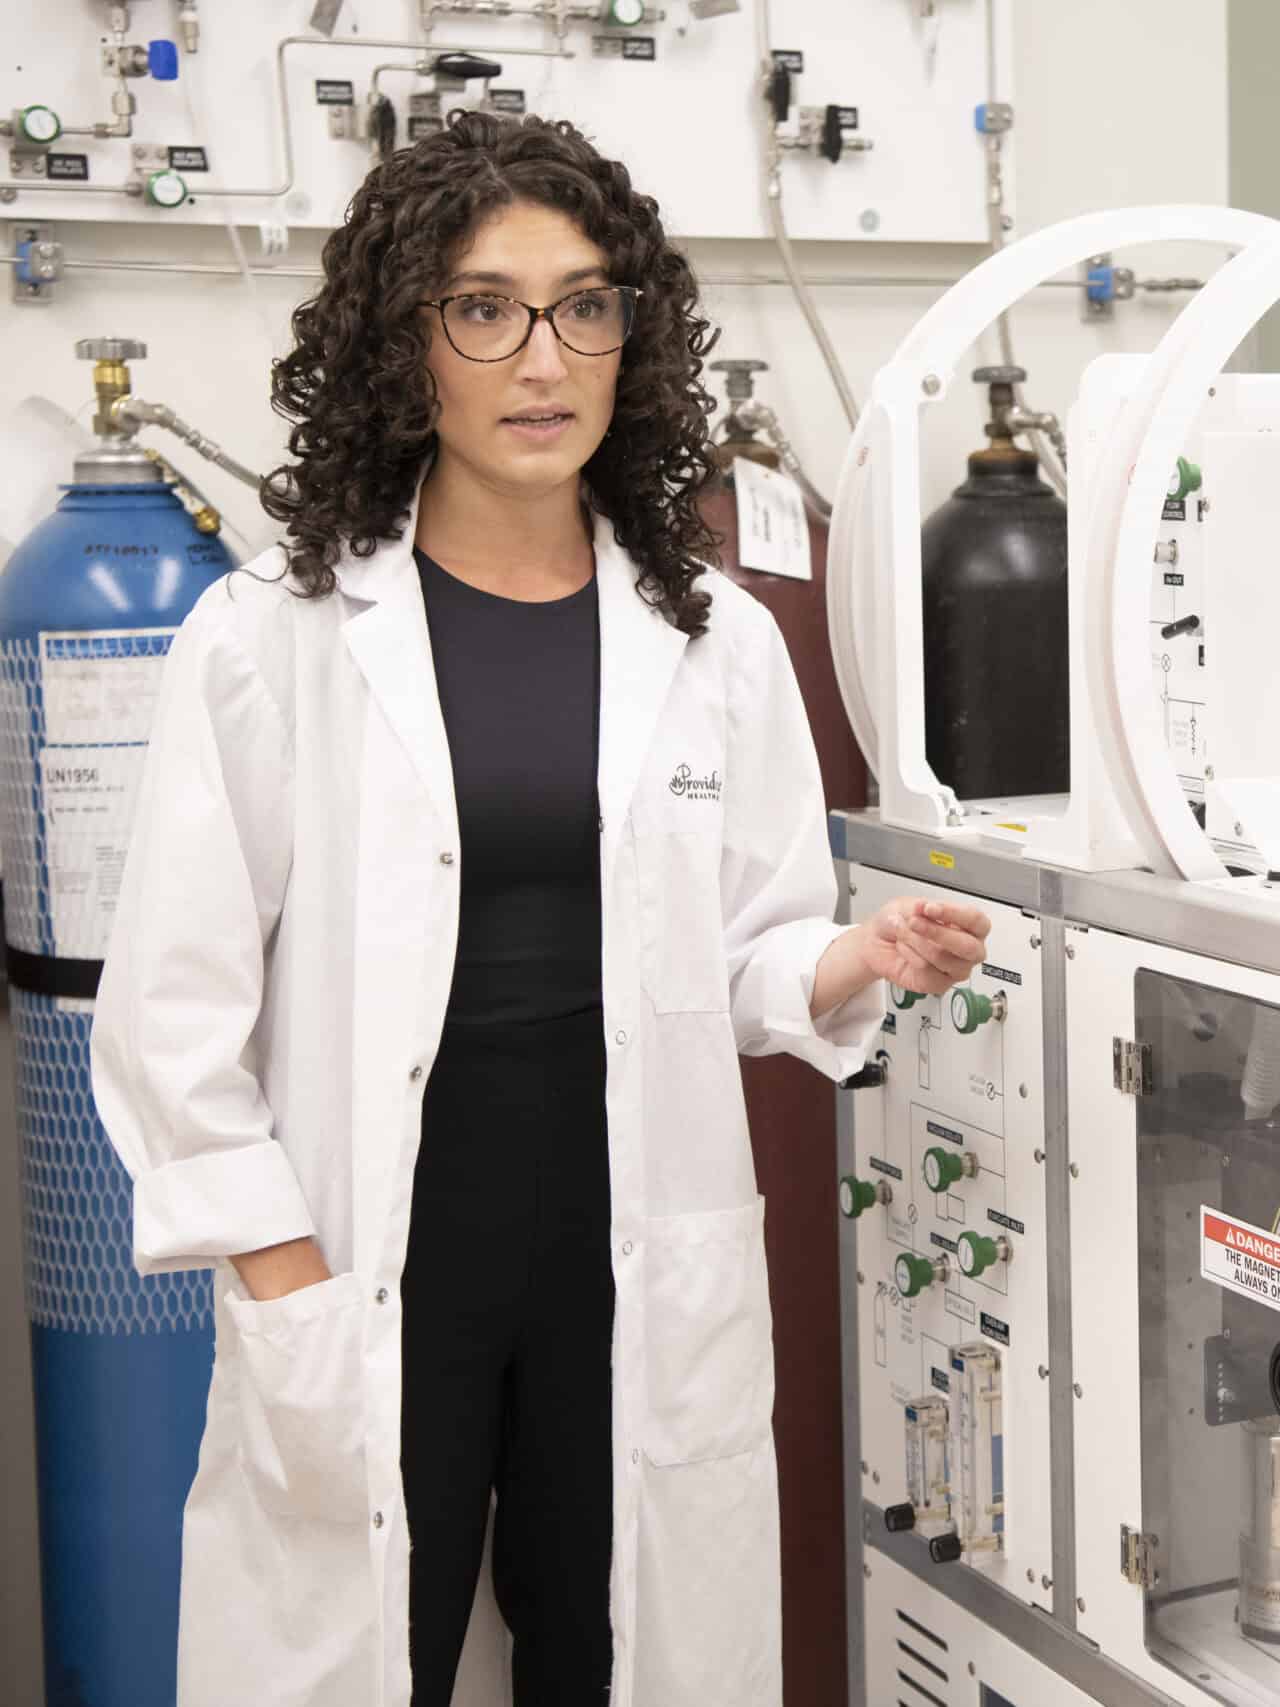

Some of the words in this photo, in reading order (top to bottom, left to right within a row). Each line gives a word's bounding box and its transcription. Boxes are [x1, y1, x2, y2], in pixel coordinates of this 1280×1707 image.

[1225, 1248, 1241, 1266] THE
[1244, 1256, 1280, 1282] MAGNET
[1234, 1269, 1268, 1294] ALWAYS
